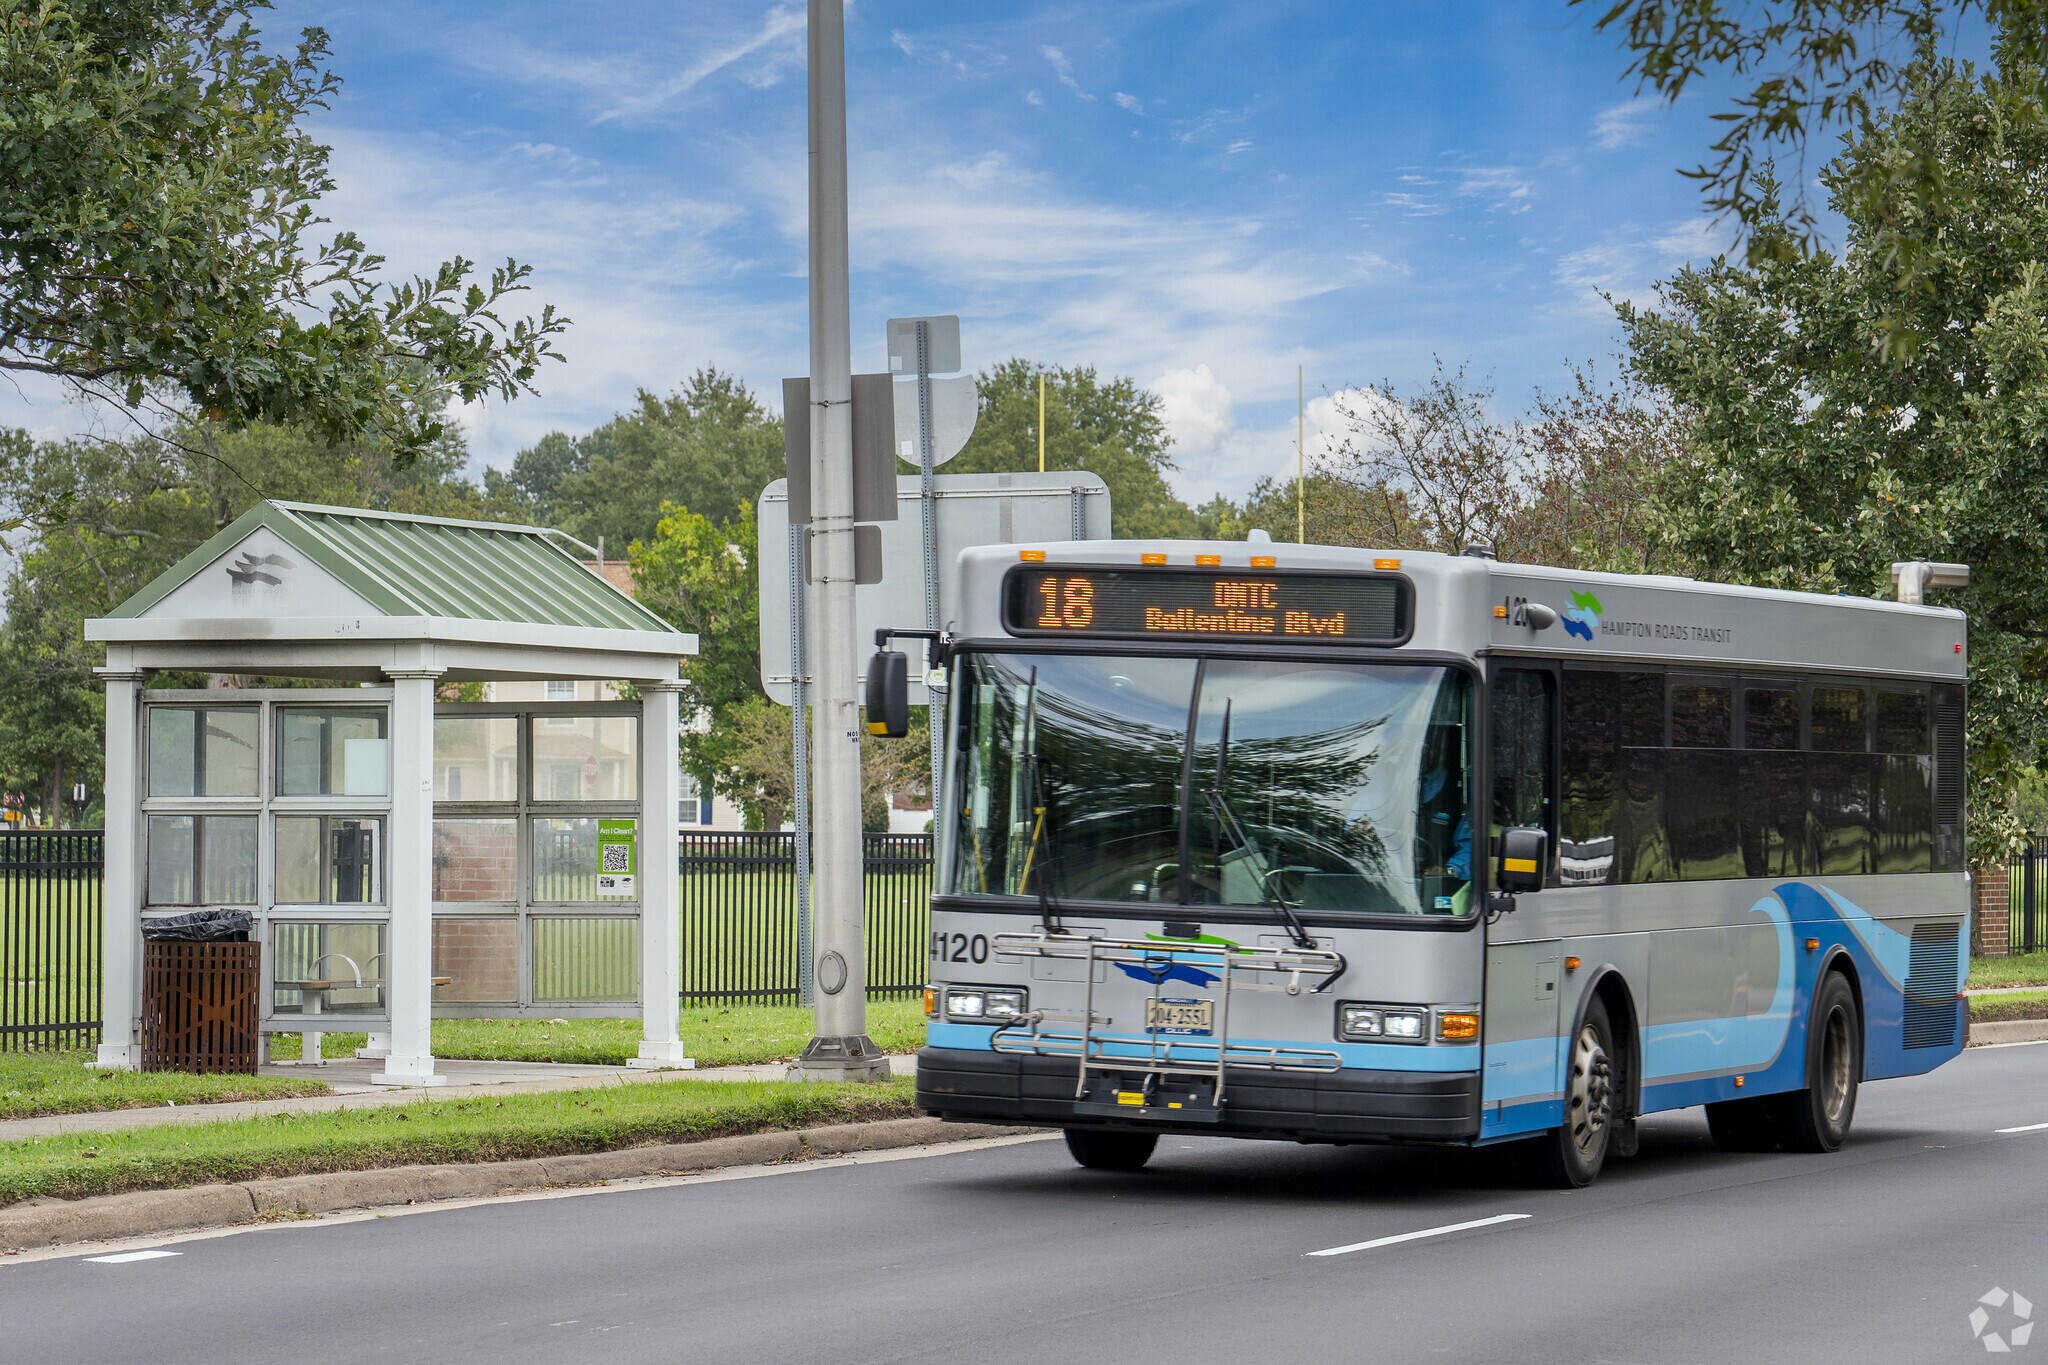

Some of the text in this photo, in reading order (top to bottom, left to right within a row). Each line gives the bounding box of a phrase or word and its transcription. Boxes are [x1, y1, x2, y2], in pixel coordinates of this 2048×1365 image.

[1038, 577, 1094, 628] 18
[1145, 607, 1345, 635] Ballentine Blvd
[1601, 620, 1732, 643] HAMPTON ROADS TRANSIT
[613, 827, 634, 835] Clean?
[1149, 1007, 1209, 1025] 204-255L
